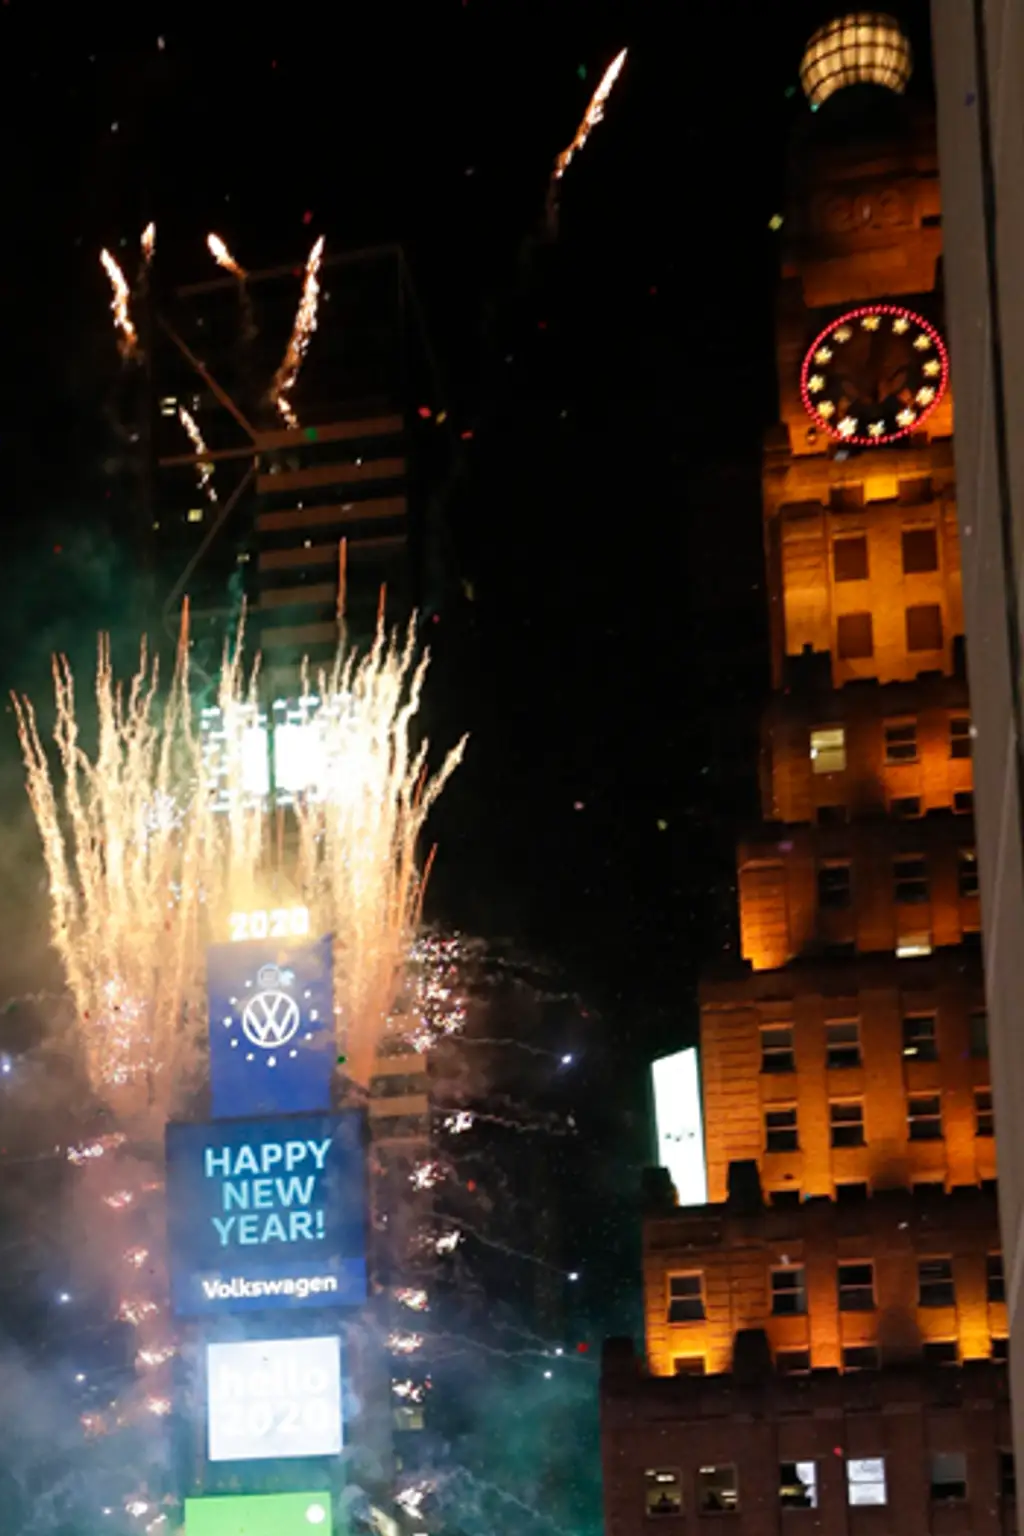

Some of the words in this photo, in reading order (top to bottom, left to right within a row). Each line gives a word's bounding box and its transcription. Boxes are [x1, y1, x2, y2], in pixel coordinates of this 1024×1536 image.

[230, 906, 309, 941] 2020
[204, 1138, 333, 1178] HAPPY
[222, 1175, 316, 1211] NEW
[210, 1209, 326, 1247] YEAR!
[202, 1275, 338, 1299] Volkswagen
[220, 1396, 332, 1437] 2020
